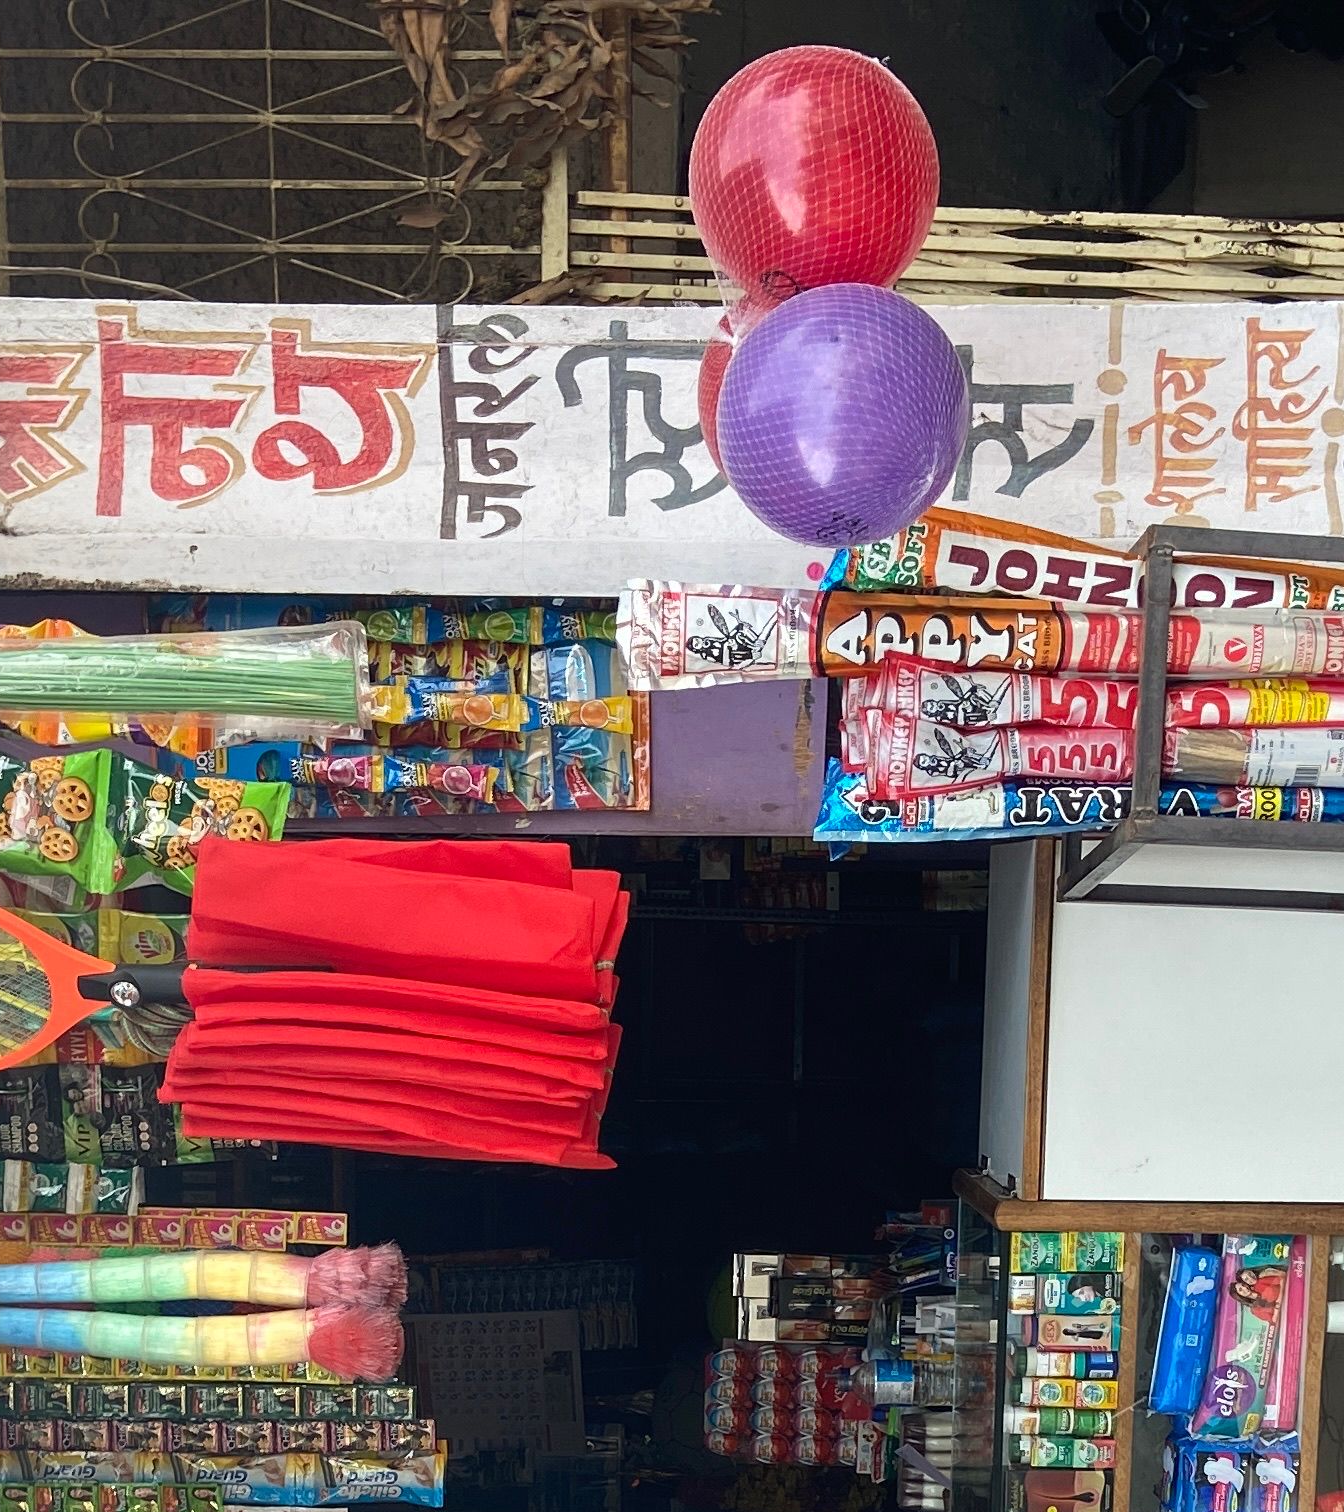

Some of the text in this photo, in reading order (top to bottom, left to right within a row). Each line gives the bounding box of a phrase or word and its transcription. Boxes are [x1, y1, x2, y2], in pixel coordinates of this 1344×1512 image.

[439, 304, 539, 540] जनरल
[1128, 349, 1226, 515] शालेय
[1231, 317, 1329, 511] साहित्य
[826, 608, 1014, 666] APPY
[1016, 612, 1038, 671] CAT
[1251, 625, 1264, 672] VIBHAVA
[1326, 621, 1344, 672] ONKEY
[896, 668, 914, 716] ONKEY
[888, 717, 906, 787] MONKEY
[1008, 784, 1202, 824] VRAT
[69, 1030, 88, 1063] EVIVE
[9, 1115, 23, 1154] SHAMPOO
[74, 1124, 92, 1156] VIP
[1031, 1238, 1039, 1267] ZANDU
[1046, 1242, 1055, 1264] Balm
[1086, 1237, 1096, 1266] ZANDU
[1103, 1241, 1111, 1262] Balm
[1046, 1319, 1055, 1343] SESA
